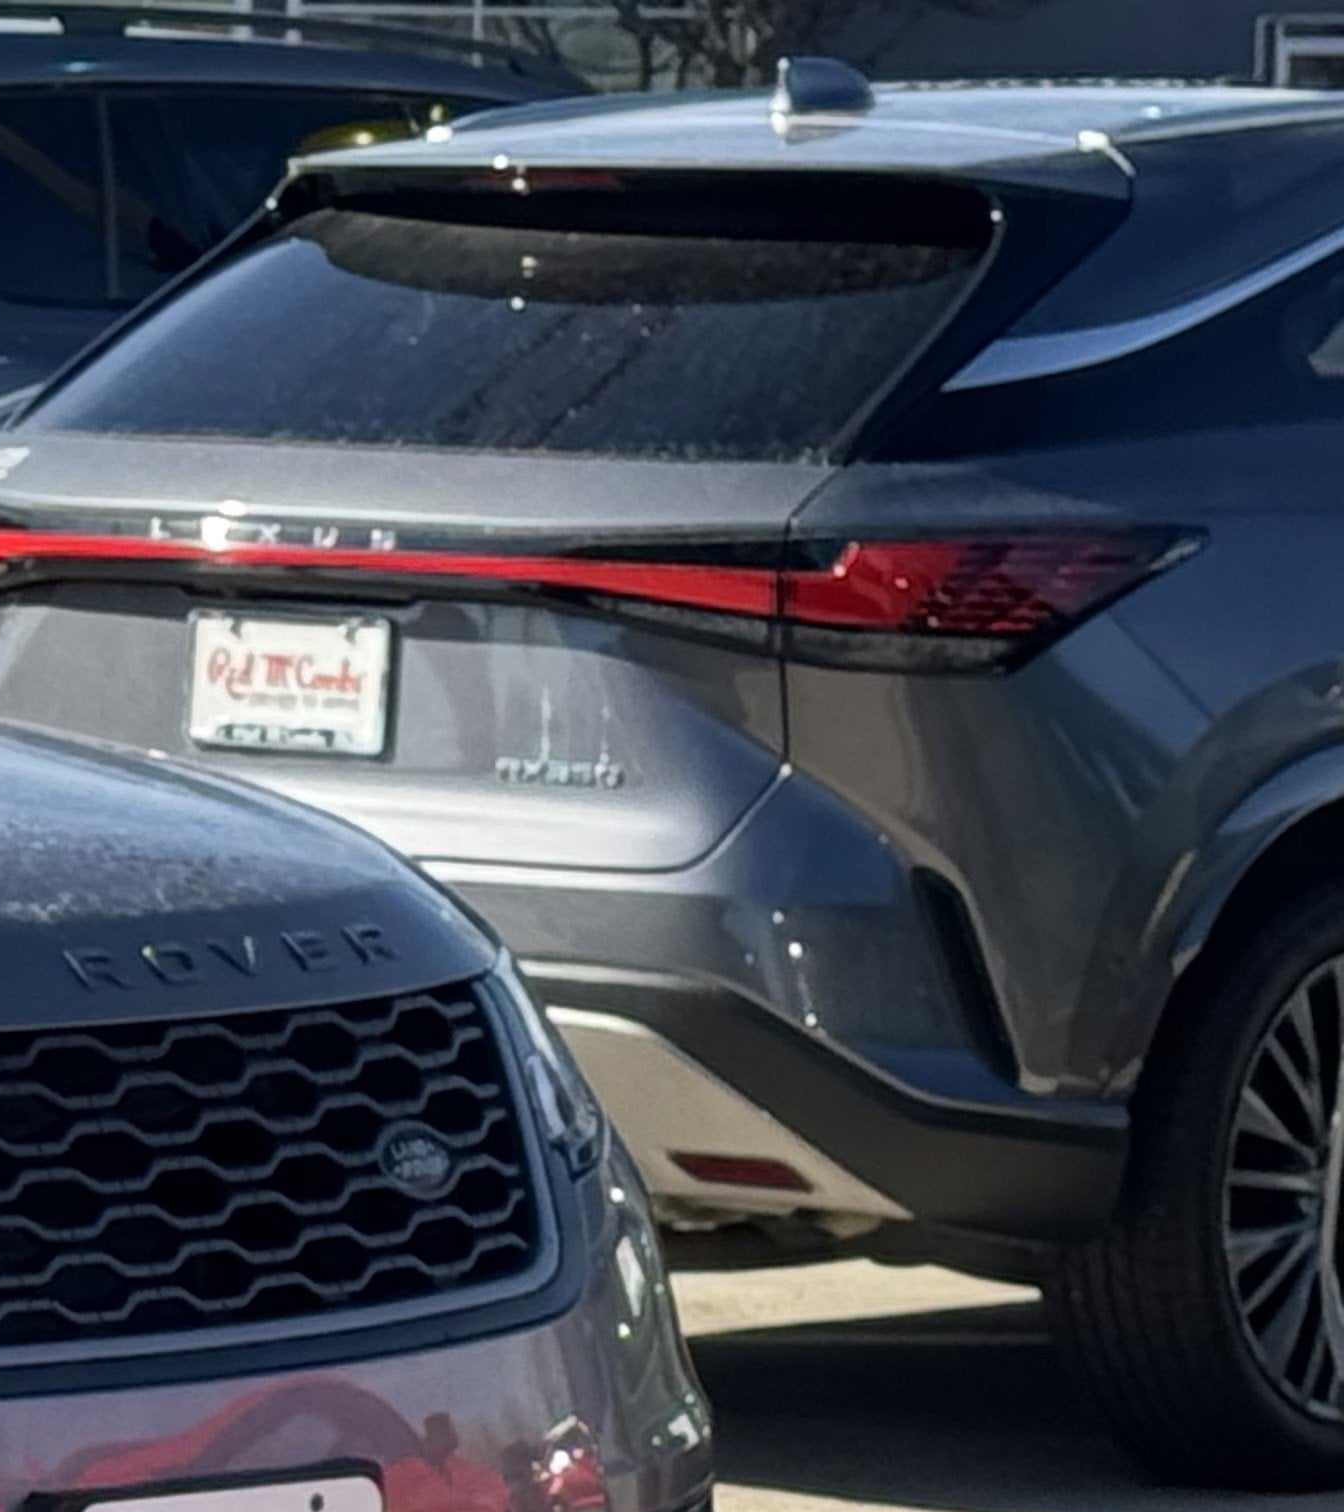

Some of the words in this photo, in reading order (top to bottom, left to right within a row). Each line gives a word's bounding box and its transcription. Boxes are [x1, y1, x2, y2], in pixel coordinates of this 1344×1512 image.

[150, 515, 397, 551] LEXUS
[207, 647, 255, 700] Red
[62, 923, 400, 993] ROVER
